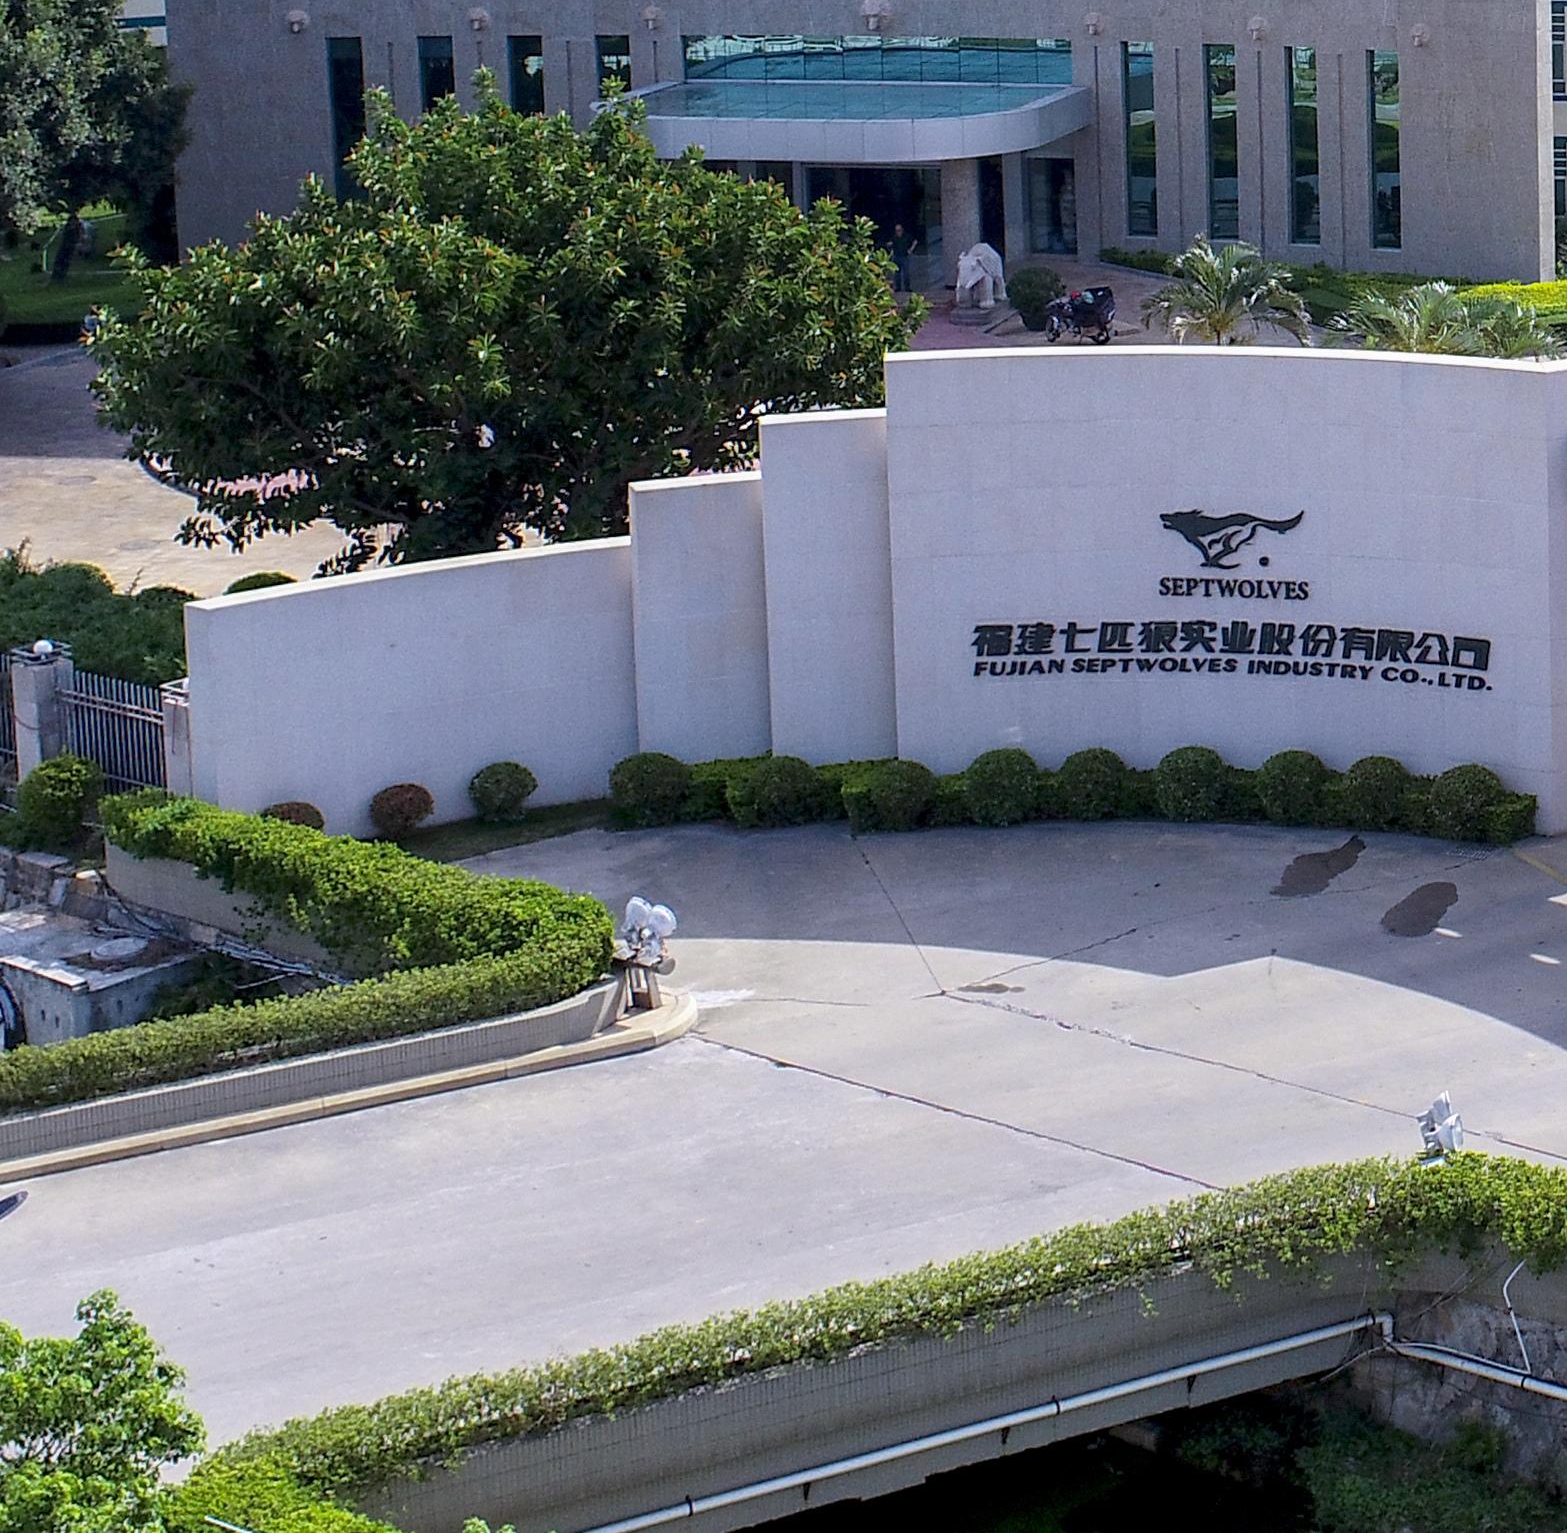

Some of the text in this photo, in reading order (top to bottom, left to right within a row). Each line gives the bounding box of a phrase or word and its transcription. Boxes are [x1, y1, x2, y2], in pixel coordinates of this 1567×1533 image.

[1158, 576, 1309, 601] SEPTWOLVES
[971, 619, 1491, 671] 福建七匹狼实业股份有限公司
[973, 659, 1065, 677] FUJIAN
[1070, 657, 1239, 674] SEPTWOLVES
[1247, 659, 1374, 681] INDUSTRY
